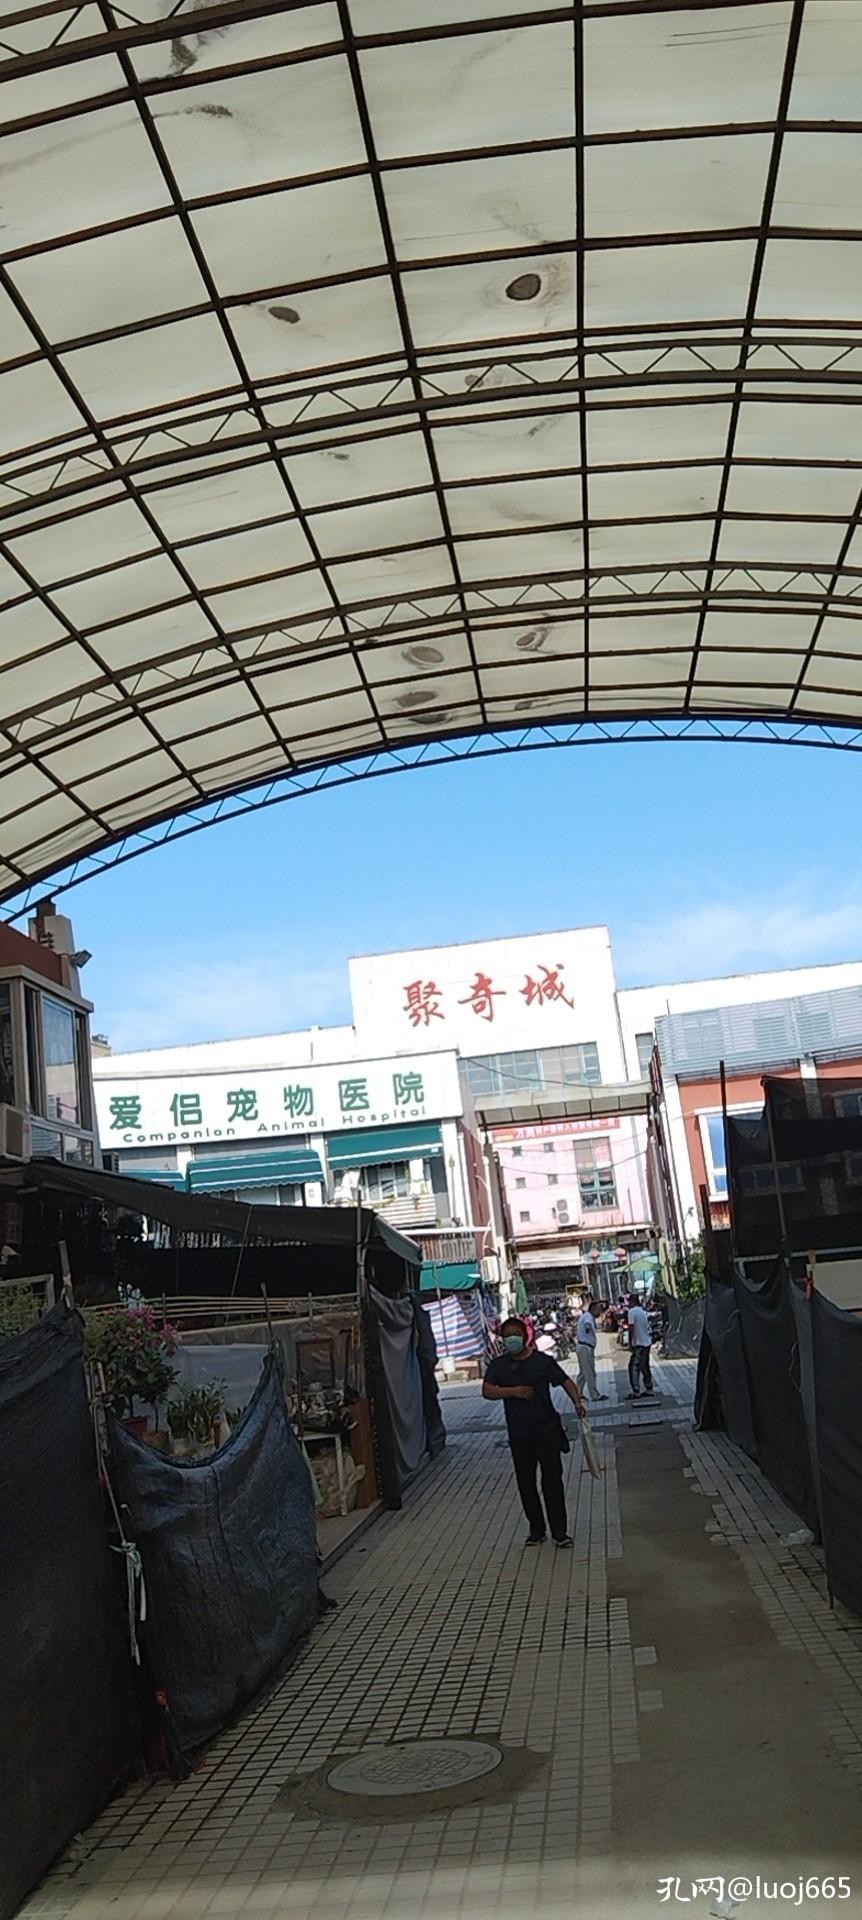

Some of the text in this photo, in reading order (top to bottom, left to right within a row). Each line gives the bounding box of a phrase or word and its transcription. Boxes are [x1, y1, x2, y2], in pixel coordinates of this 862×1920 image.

[403, 963, 575, 1027] 聚奇城
[109, 1072, 425, 1130] 爱侣宠物医院
[122, 1106, 427, 1143] Companion Animal Hospital
